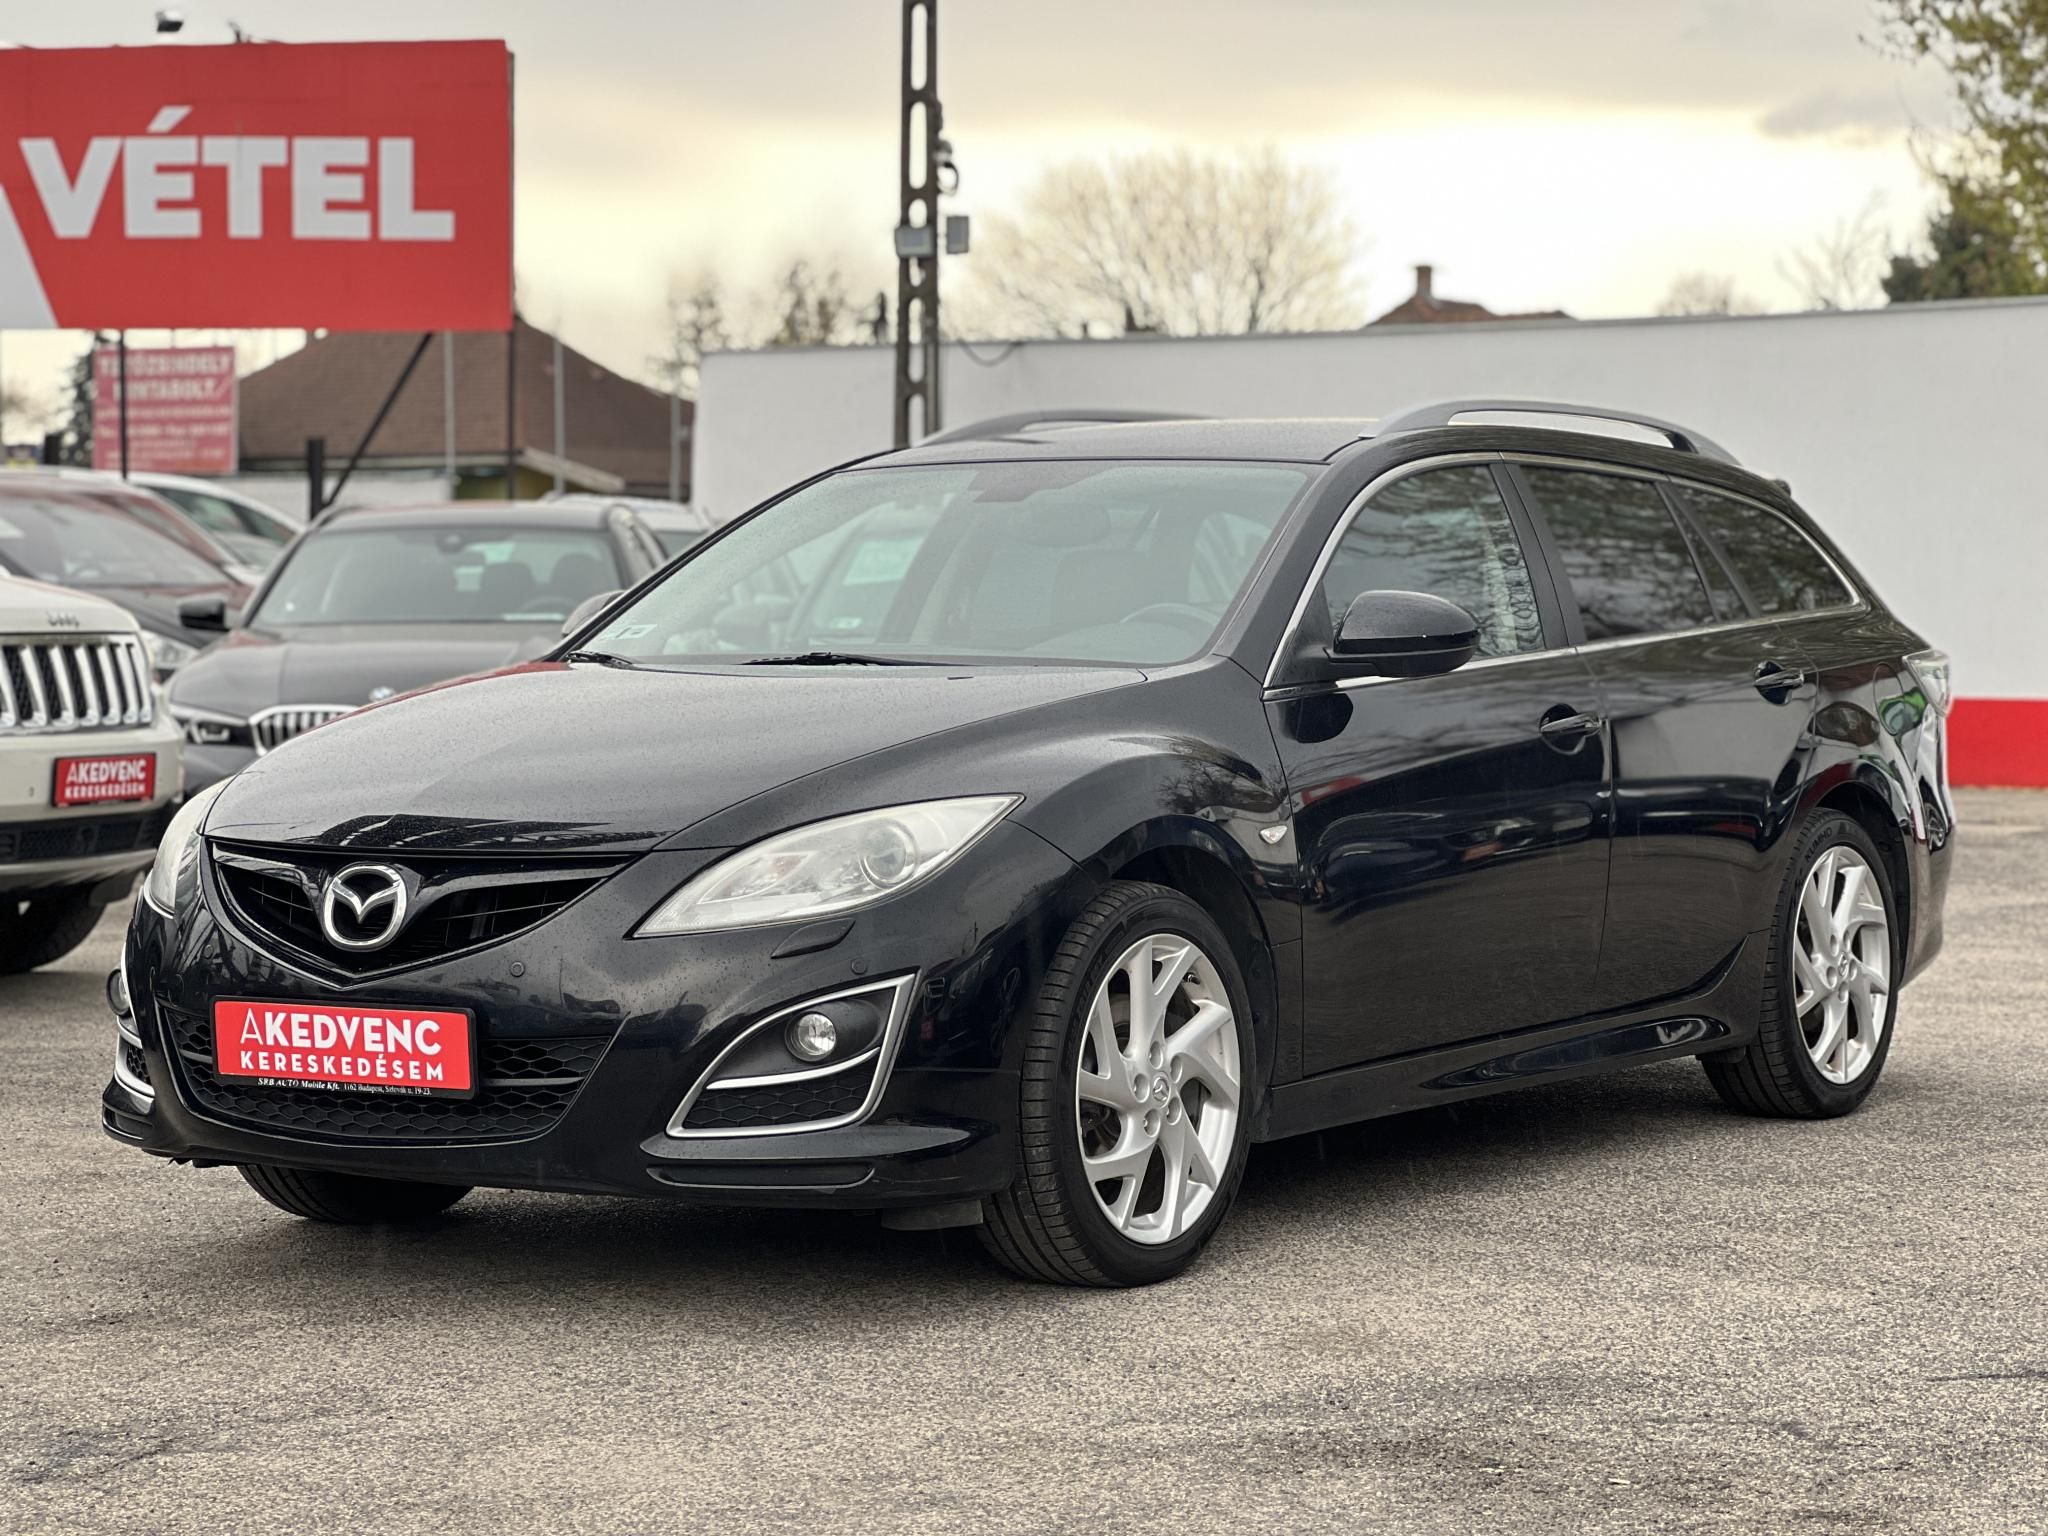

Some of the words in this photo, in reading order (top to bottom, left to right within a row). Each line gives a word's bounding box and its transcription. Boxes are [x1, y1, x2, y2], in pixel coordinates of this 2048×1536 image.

[19, 106, 455, 240] VÉTEL
[66, 759, 146, 784] AKEDVENC
[1805, 827, 1832, 862] KUMHO
[240, 1008, 441, 1055] AKEDVENC
[240, 1050, 443, 1081] KERESKEDÉSEM
[257, 1077, 275, 1086] SRB
[276, 1079, 300, 1087] AUTO
[301, 1080, 325, 1089] Mobile
